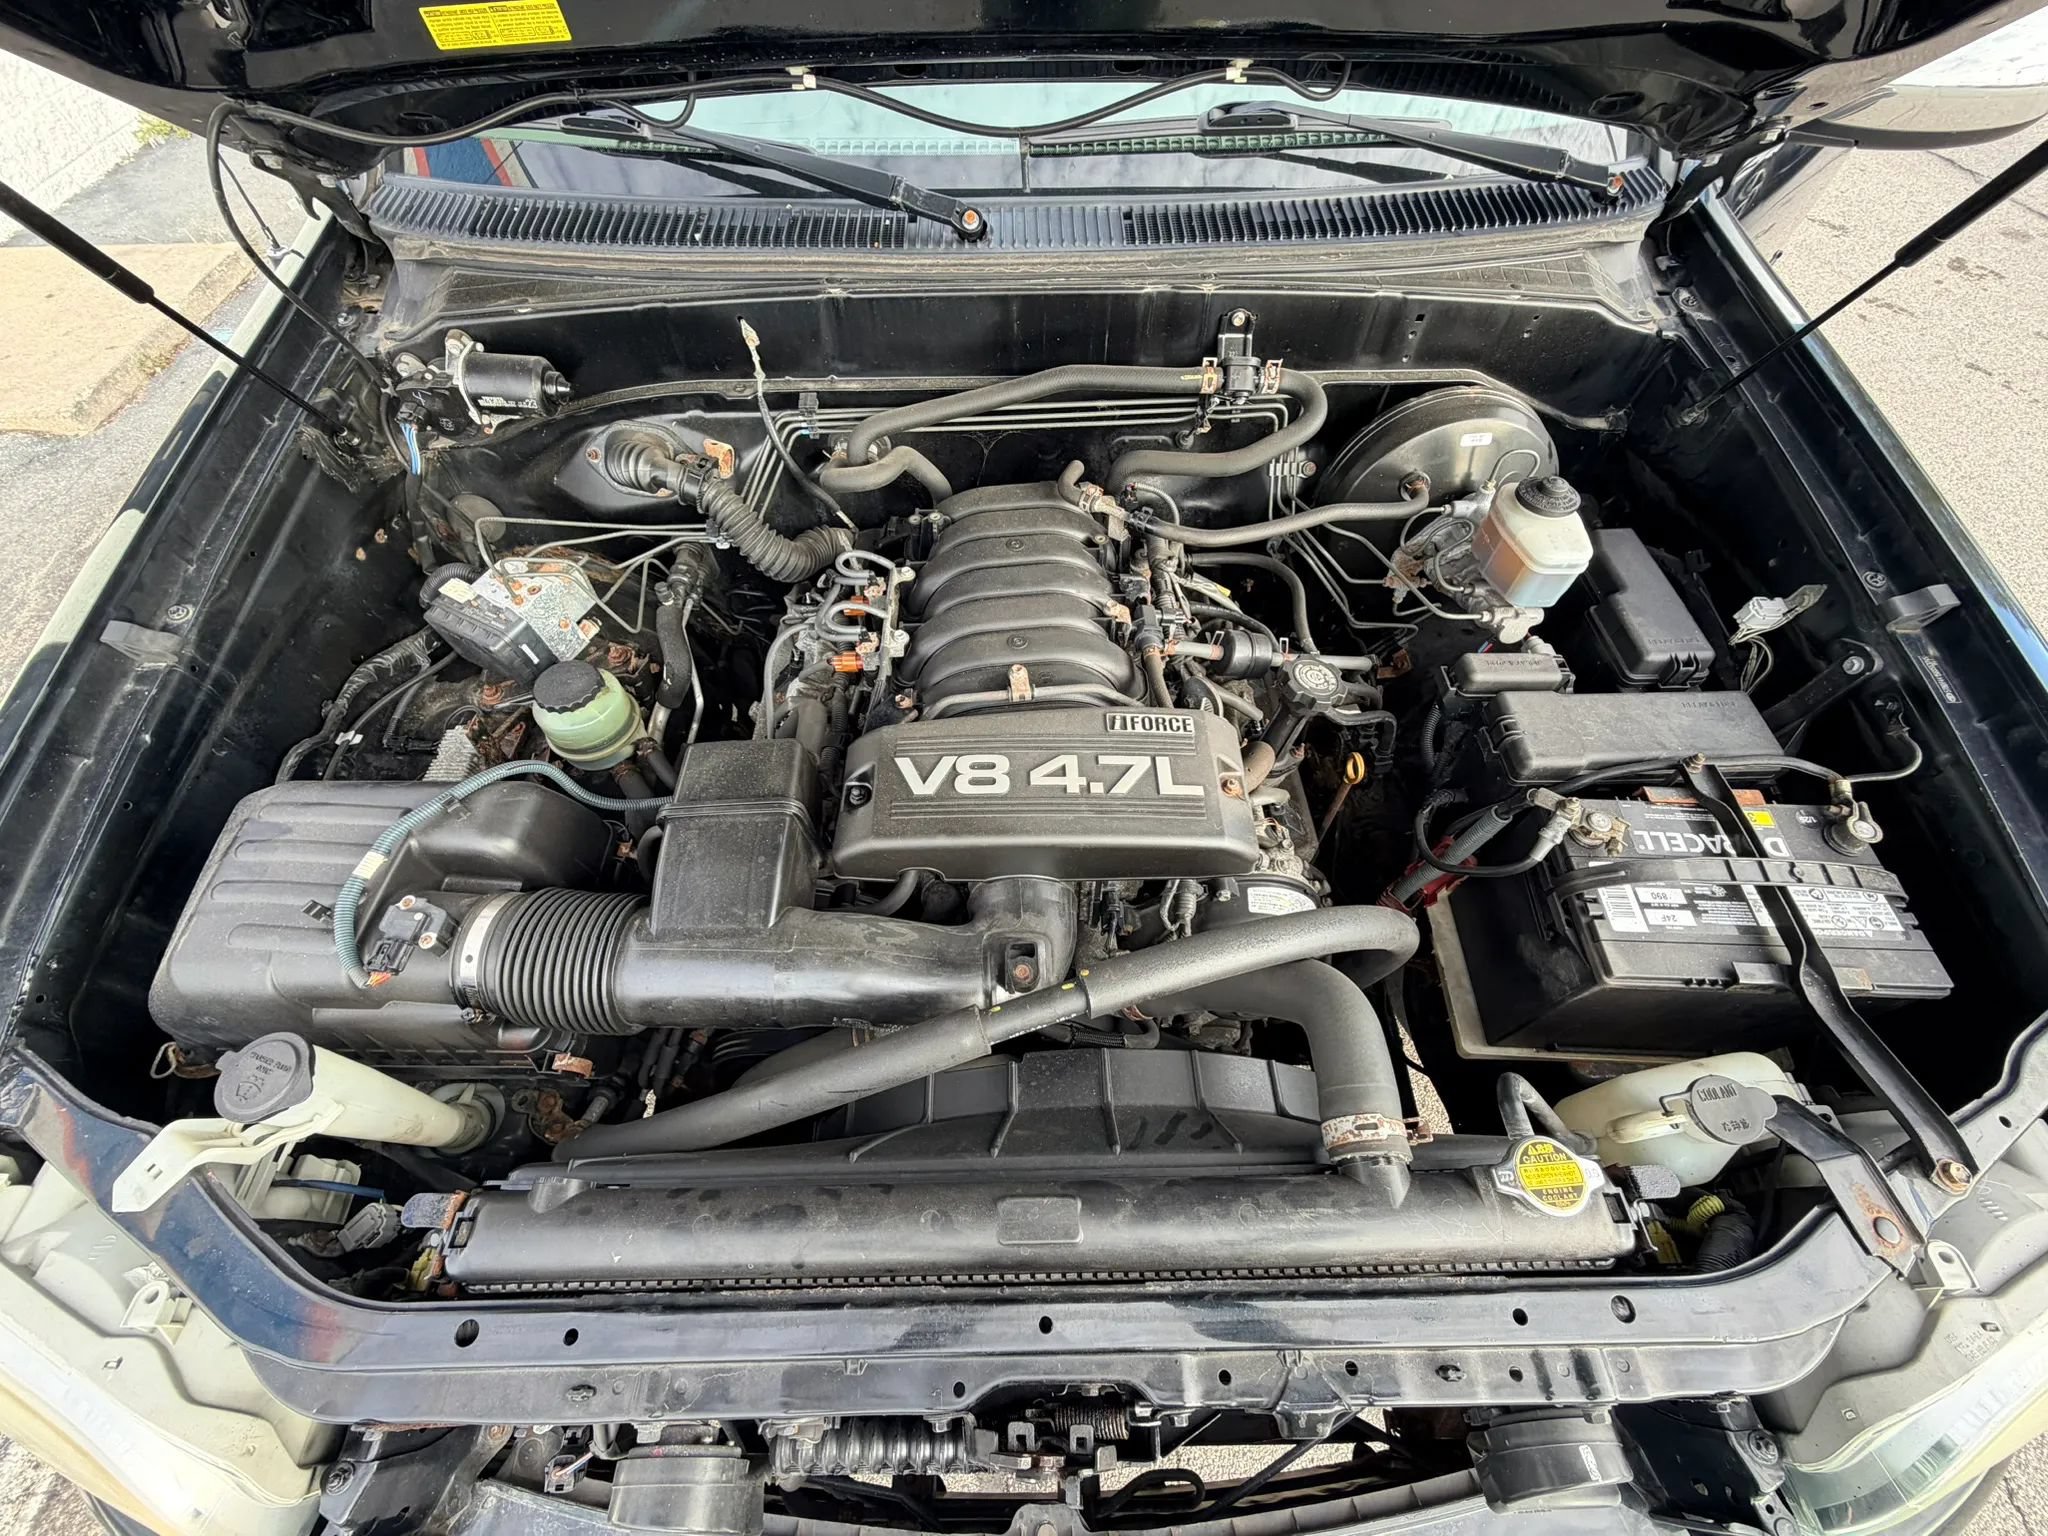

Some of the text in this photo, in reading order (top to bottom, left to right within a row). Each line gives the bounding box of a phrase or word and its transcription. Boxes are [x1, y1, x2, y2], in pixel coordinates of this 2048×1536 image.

[893, 754, 1205, 797] V8 4.7L
[1634, 829, 1791, 859] DRACELL
[1696, 1083, 1738, 1103] COOLANT
[1522, 1152, 1567, 1164] CAUTION
